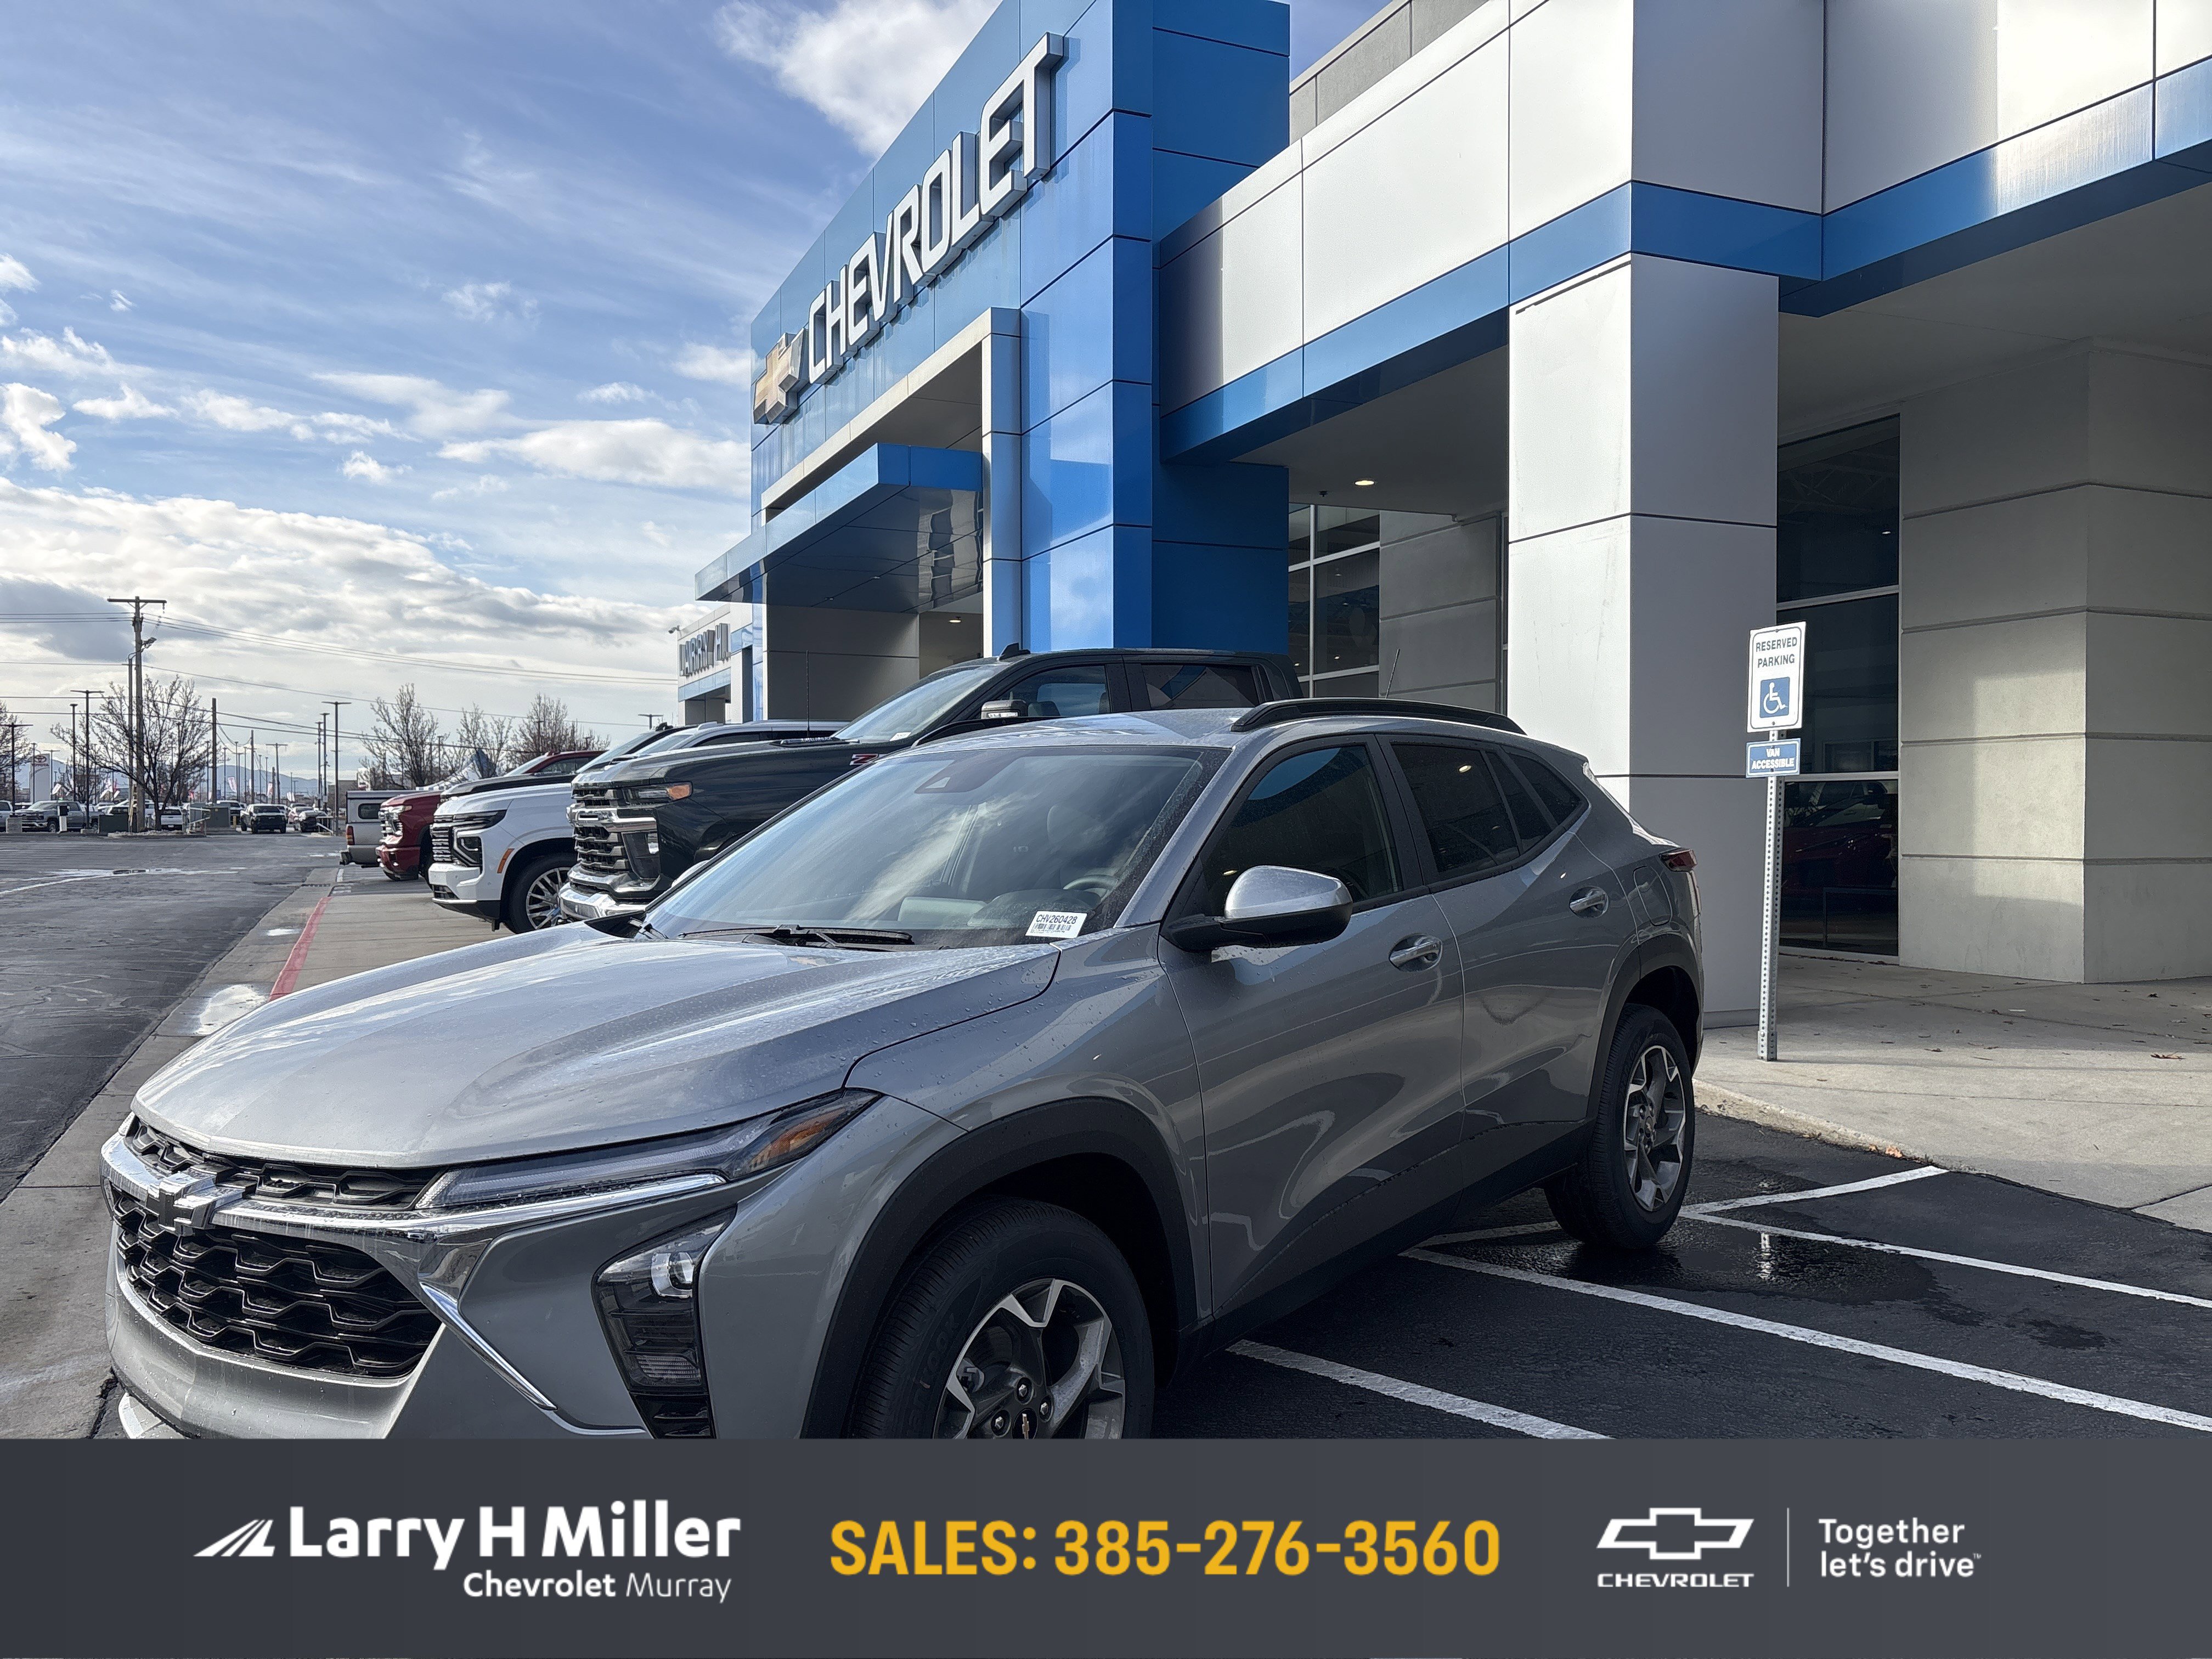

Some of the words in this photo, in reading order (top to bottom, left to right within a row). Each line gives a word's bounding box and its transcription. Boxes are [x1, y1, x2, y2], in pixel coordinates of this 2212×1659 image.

[809, 32, 1063, 385] CHEVROLET
[1756, 636, 1798, 653] RESERVED
[679, 629, 715, 677] LARRY
[1757, 653, 1795, 669] PARKING
[1766, 747, 1780, 758] VAN
[1751, 757, 1795, 770] ACCESSIBLE
[1036, 914, 1078, 924] CHV260428
